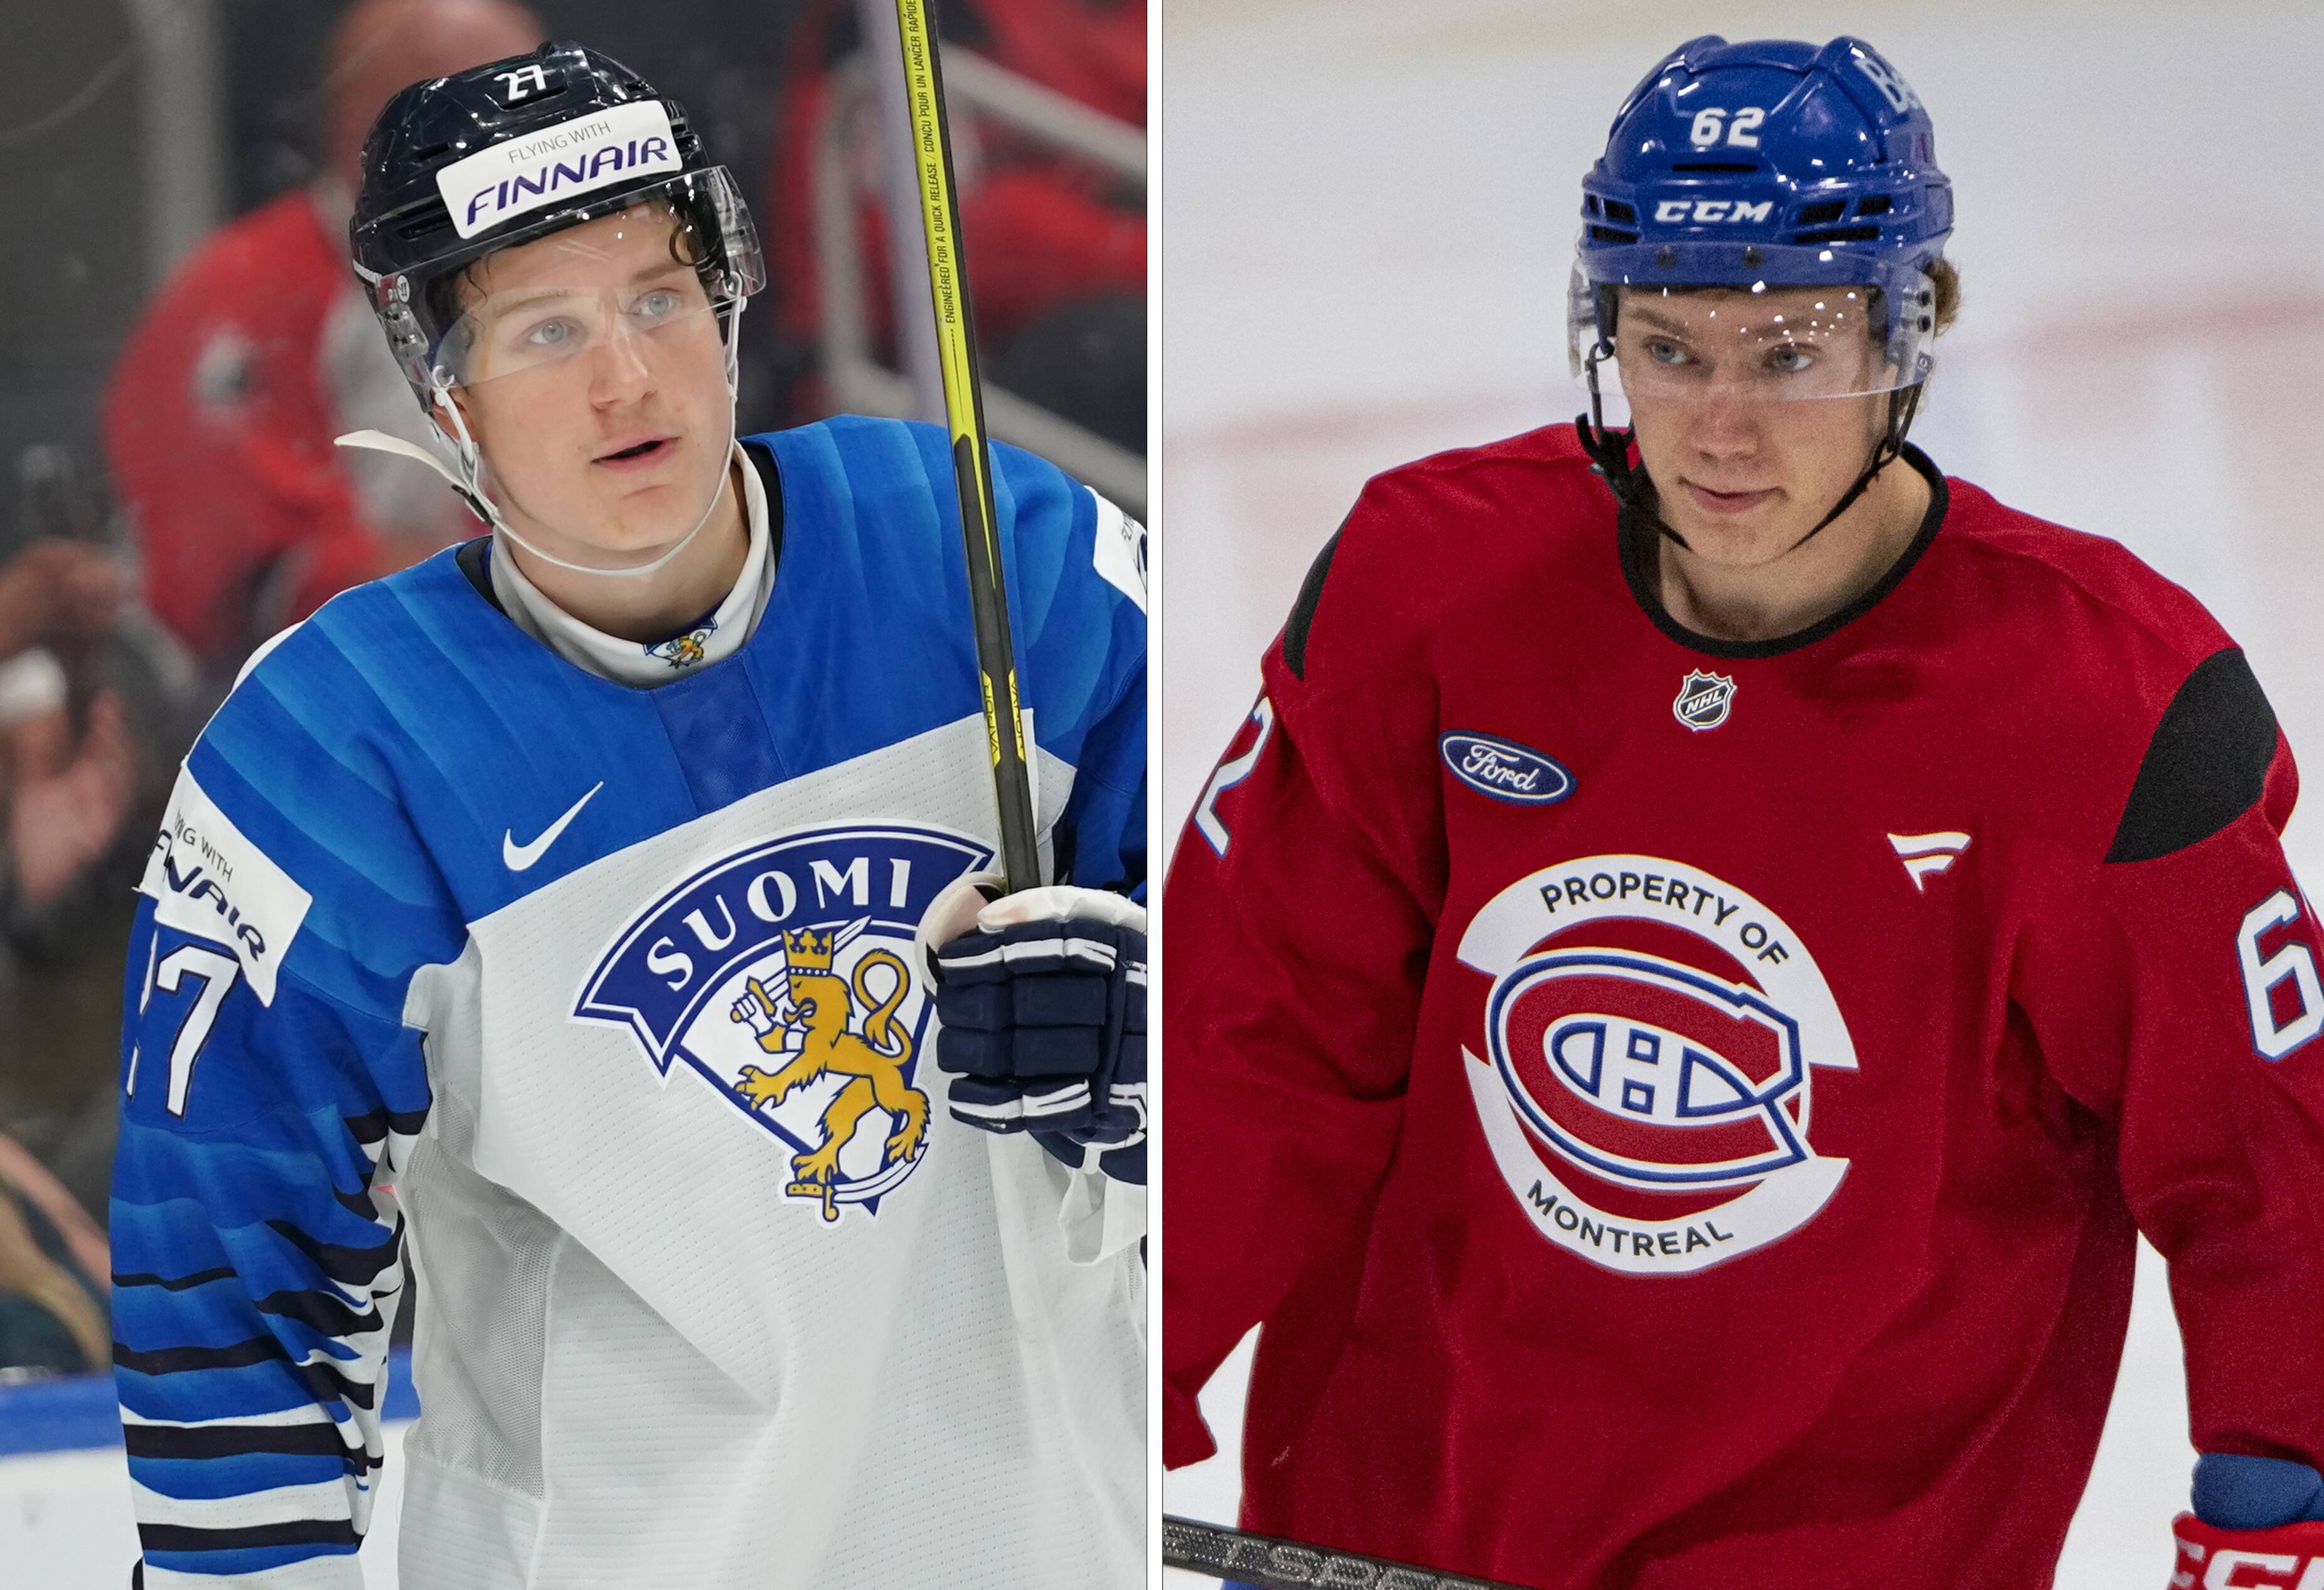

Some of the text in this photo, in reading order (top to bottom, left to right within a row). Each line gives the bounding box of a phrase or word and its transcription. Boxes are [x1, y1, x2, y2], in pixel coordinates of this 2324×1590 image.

[911, 36, 924, 71] LANCER
[493, 64, 547, 100] 27
[916, 75, 927, 88] UN
[918, 92, 930, 117] POUR
[508, 120, 611, 164] FLYING WITH
[1689, 107, 1765, 148] 62
[466, 136, 668, 226] FINNAIR
[926, 162, 940, 201] RELEASE
[931, 205, 945, 232] QUICK
[1654, 200, 1774, 223] CCM
[937, 245, 949, 263] FOR
[939, 267, 955, 323] ENGINEERED
[1685, 690, 1723, 714] NHL
[1462, 744, 1540, 791] Ford
[201, 835, 233, 883] WITH
[646, 856, 912, 992] SUOMI
[1540, 871, 1791, 965] PROPERTY OF
[126, 924, 242, 1120] 7
[1527, 1178, 1733, 1257] MONTREAL
